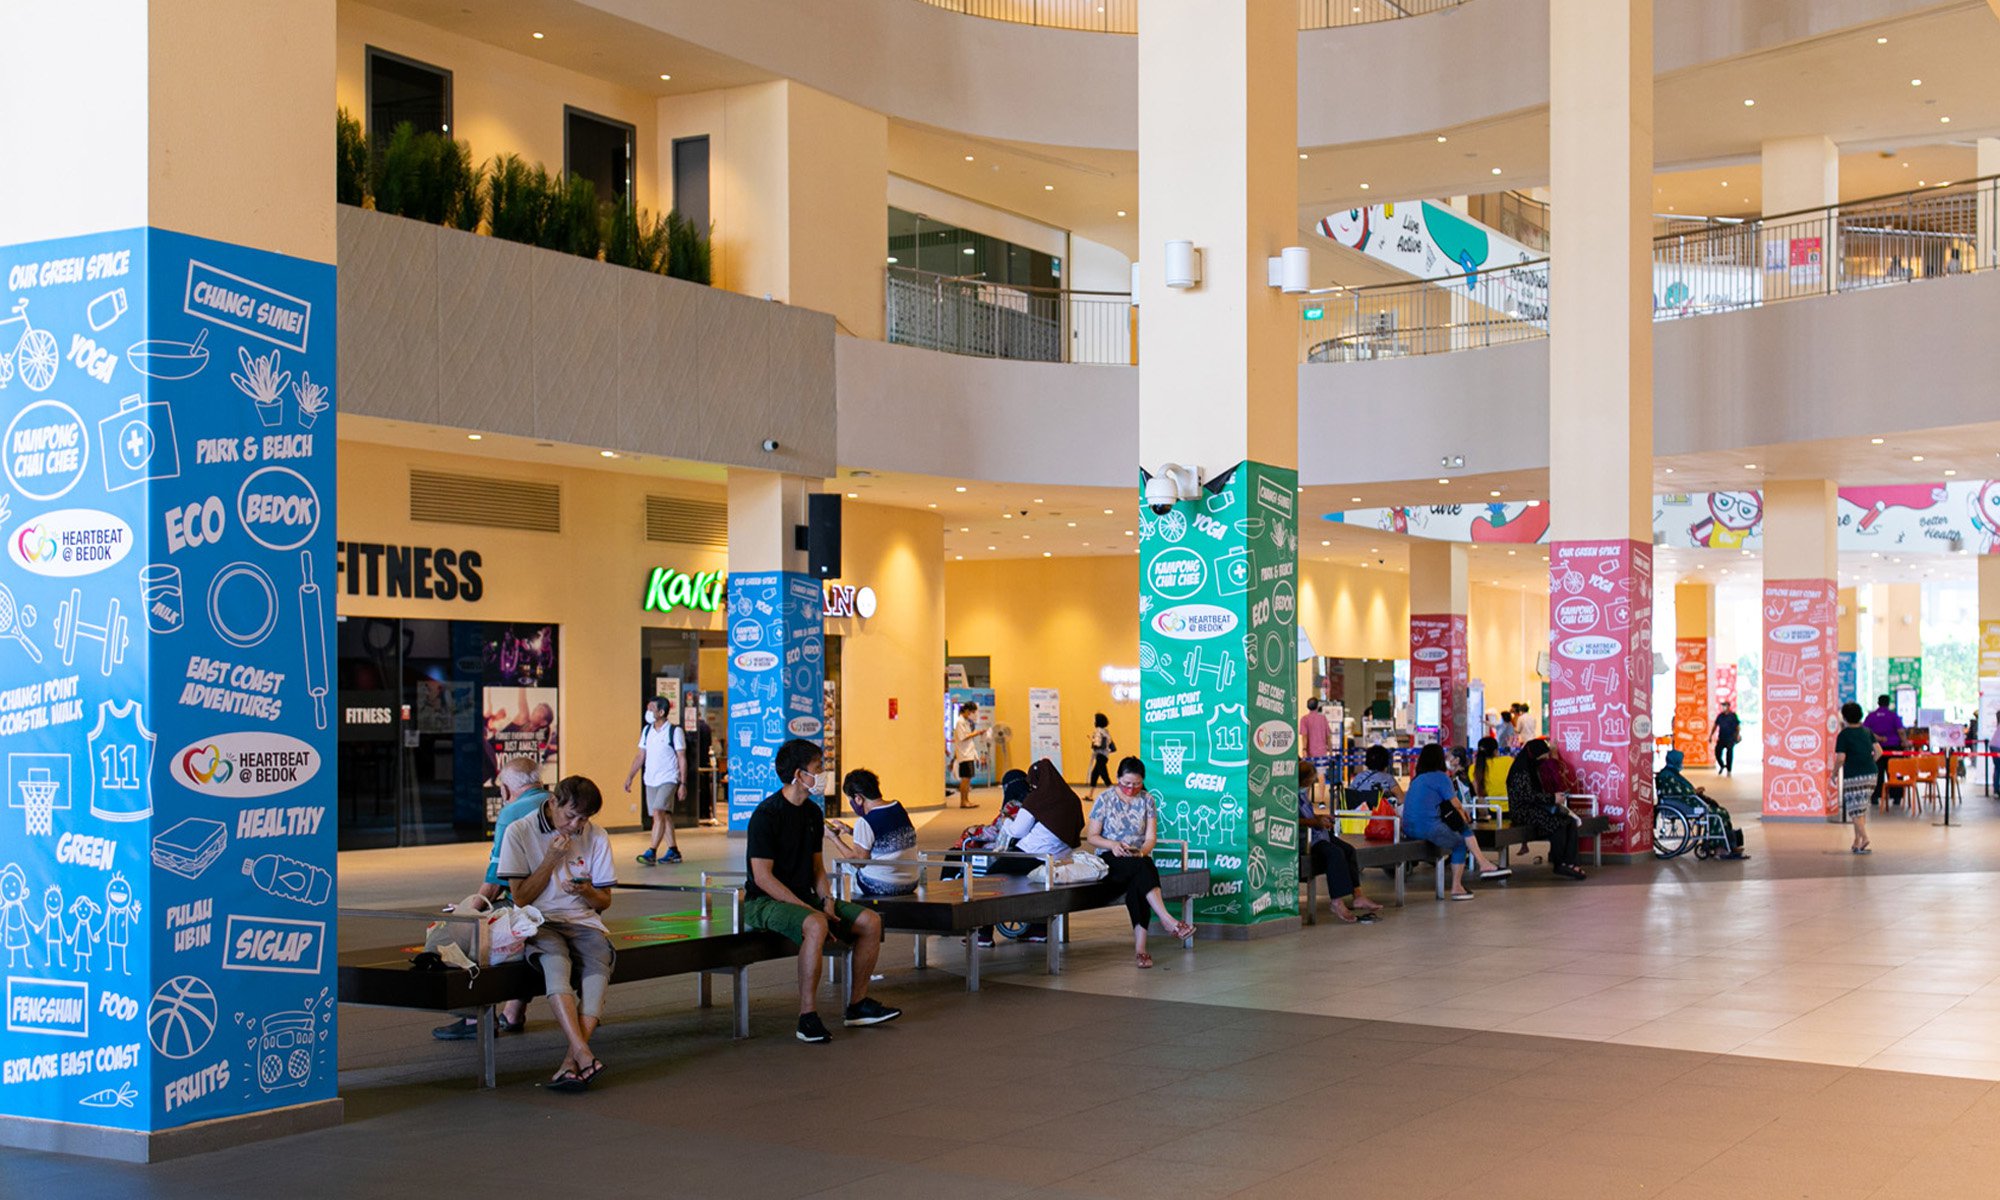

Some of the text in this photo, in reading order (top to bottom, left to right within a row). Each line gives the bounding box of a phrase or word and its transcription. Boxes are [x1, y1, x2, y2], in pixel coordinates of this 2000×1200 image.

[8, 250, 131, 291] OUR GREEN SPACE
[193, 281, 305, 334] CHANGI SIMEI
[67, 334, 118, 384] YOGA
[13, 422, 79, 453] KAMPONG
[196, 434, 314, 464] PARK & BEACH
[14, 446, 79, 478] CHAI CHEE
[246, 494, 314, 526] BEDOK
[1920, 516, 1948, 526] Better
[165, 495, 226, 554] ECO
[1192, 513, 1228, 542] YOGA
[1924, 528, 1962, 542] Health
[62, 528, 124, 546] HEARTBEAT
[62, 545, 112, 562] @ BEDOK
[1558, 546, 1621, 558] OUR GREEN SPACE
[1154, 560, 1200, 574] KAMPONG
[1156, 573, 1200, 588] CHAI CHEE
[1588, 574, 1614, 594] YOGA
[151, 602, 180, 625] MILK
[1252, 597, 1270, 629] ECO
[1274, 594, 1294, 612] BEDOK
[1188, 615, 1230, 624] HEARTBEAT
[1189, 623, 1223, 632] @ BEDOK
[786, 647, 800, 664] ECO
[186, 656, 285, 695] EAST COAST
[0, 674, 80, 710] CHANGI POINT
[179, 684, 282, 722] ADVENTURES
[1145, 691, 1200, 710] CHANGI POINT
[0, 699, 84, 736] COASTAL WALK
[346, 708, 392, 724] FITNESS
[1145, 703, 1204, 723] COASTAL WALK
[1215, 726, 1244, 750] 11
[1604, 718, 1626, 736] 11
[100, 744, 140, 790] 11
[240, 752, 310, 768] HEARTBEAT
[1582, 750, 1612, 764] GREEN
[240, 767, 298, 784] @ BEDOK
[1185, 772, 1226, 792] GREEN
[1603, 804, 1624, 816] FOOD
[236, 806, 326, 840] HEALTHY
[56, 832, 117, 870] GREEN
[1214, 854, 1242, 870] FOOD
[1212, 880, 1243, 896] COAST
[166, 898, 212, 930] PULAU
[174, 923, 211, 952] UBIN
[234, 929, 314, 962] SIGLAP
[12, 996, 83, 1024] FENGSHAN
[98, 990, 138, 1020] FOOD
[3, 1043, 140, 1085] EXPLORE EAST COAST
[164, 1059, 230, 1112] FRUITS
